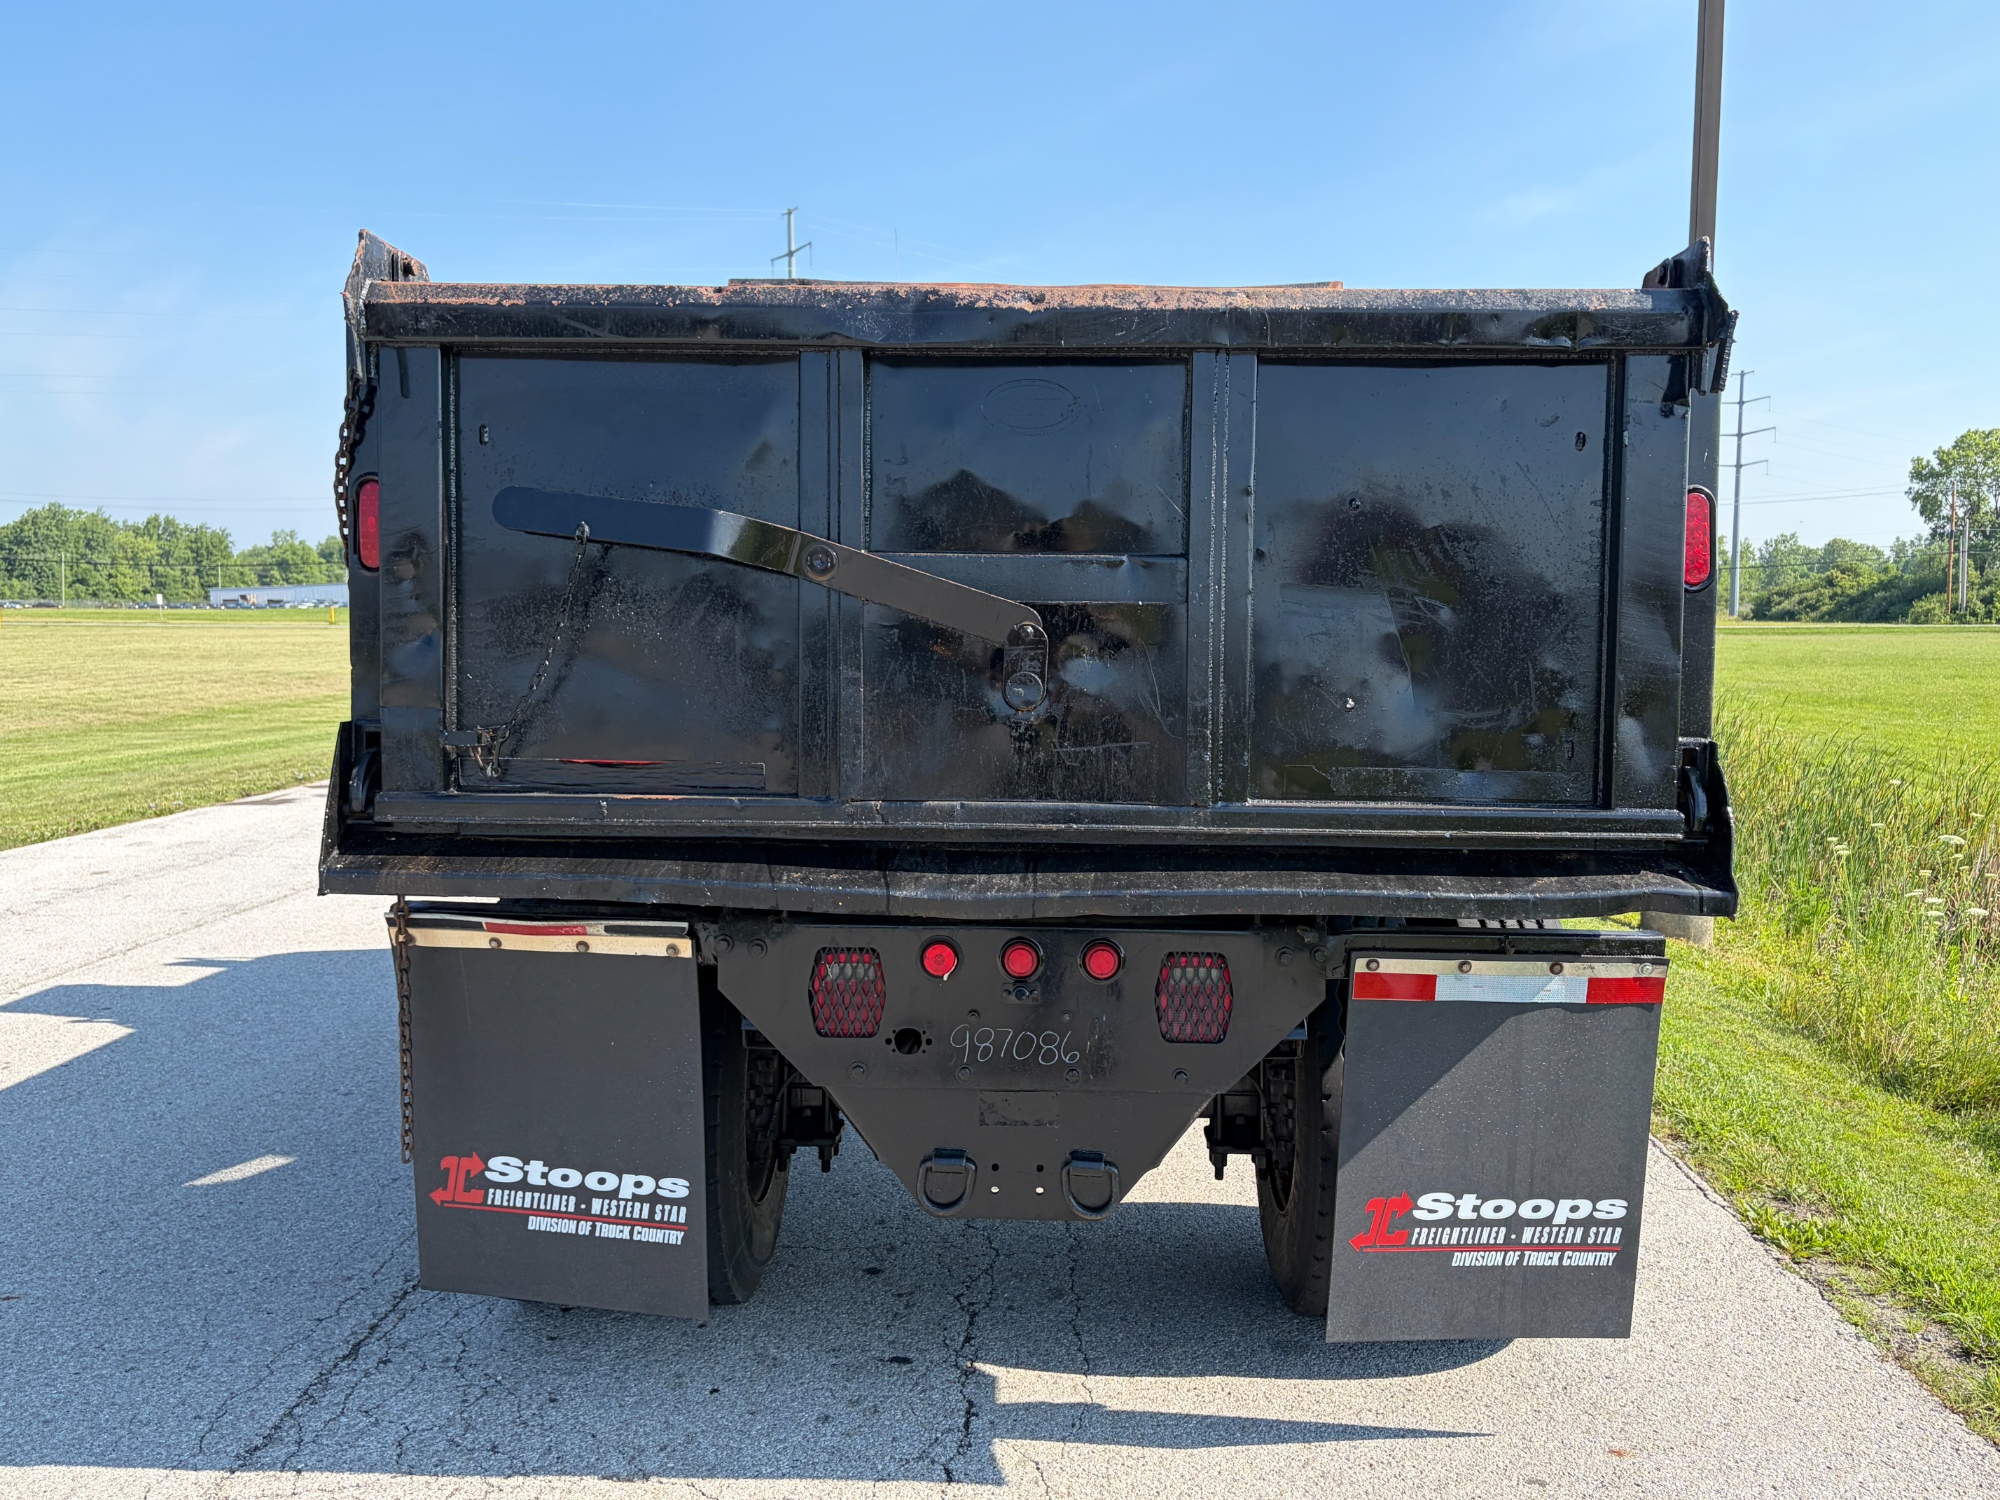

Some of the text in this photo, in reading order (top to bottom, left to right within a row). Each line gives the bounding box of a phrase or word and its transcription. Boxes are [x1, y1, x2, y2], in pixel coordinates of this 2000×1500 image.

[950, 1024, 1080, 1066] 987086
[484, 1155, 690, 1199] Stoops
[487, 1188, 687, 1224] FREIGHTLINER WESTERN STAR
[1412, 1192, 1628, 1225] Stoops
[527, 1215, 685, 1246] DIVISION OF TRUCK COUNTRY
[1411, 1226, 1623, 1246] FREIGHTLINER WESTERN STAR
[1451, 1252, 1617, 1267] DIVISION OF TRUCK COUNTRY
